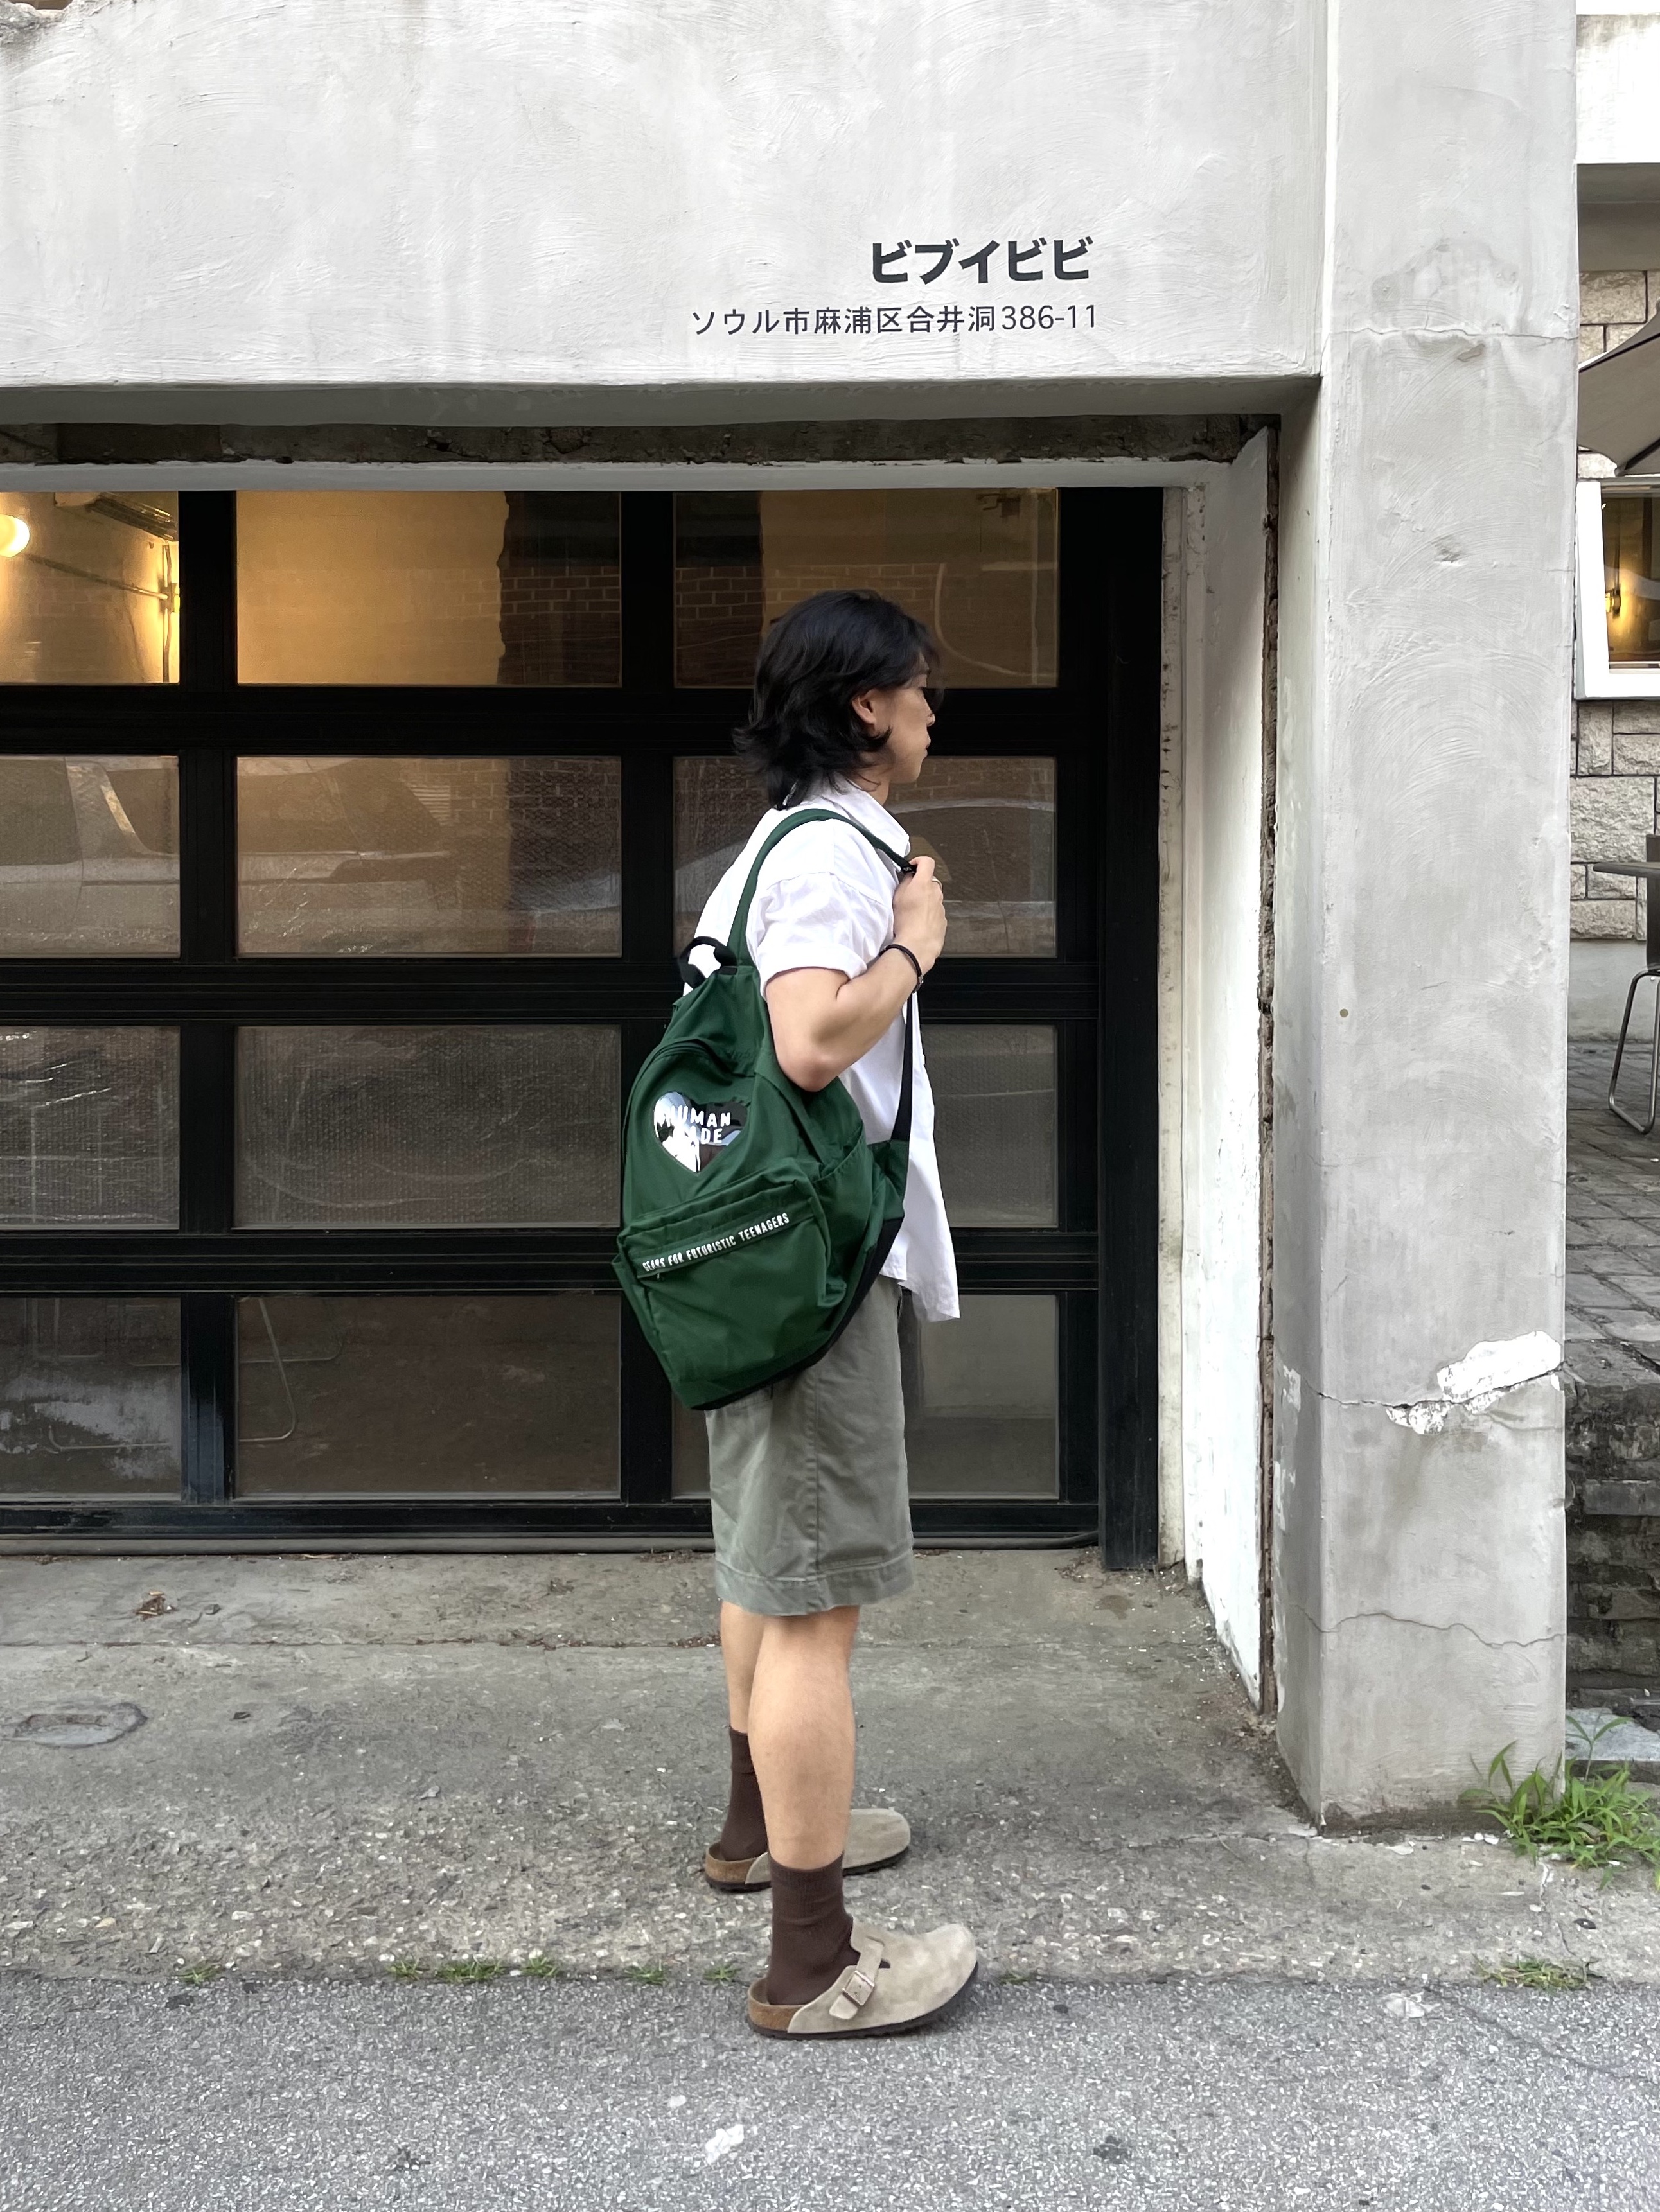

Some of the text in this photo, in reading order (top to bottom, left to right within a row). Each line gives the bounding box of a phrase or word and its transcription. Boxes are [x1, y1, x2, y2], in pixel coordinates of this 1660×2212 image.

[872, 236, 1093, 285] ビブイビビ
[692, 304, 1095, 335] ソウル市麻浦区合井洞386-11
[667, 1252, 685, 1266] FOR
[685, 1235, 736, 1260] FUTURISTIC
[738, 1213, 790, 1241] TEENAGERS
